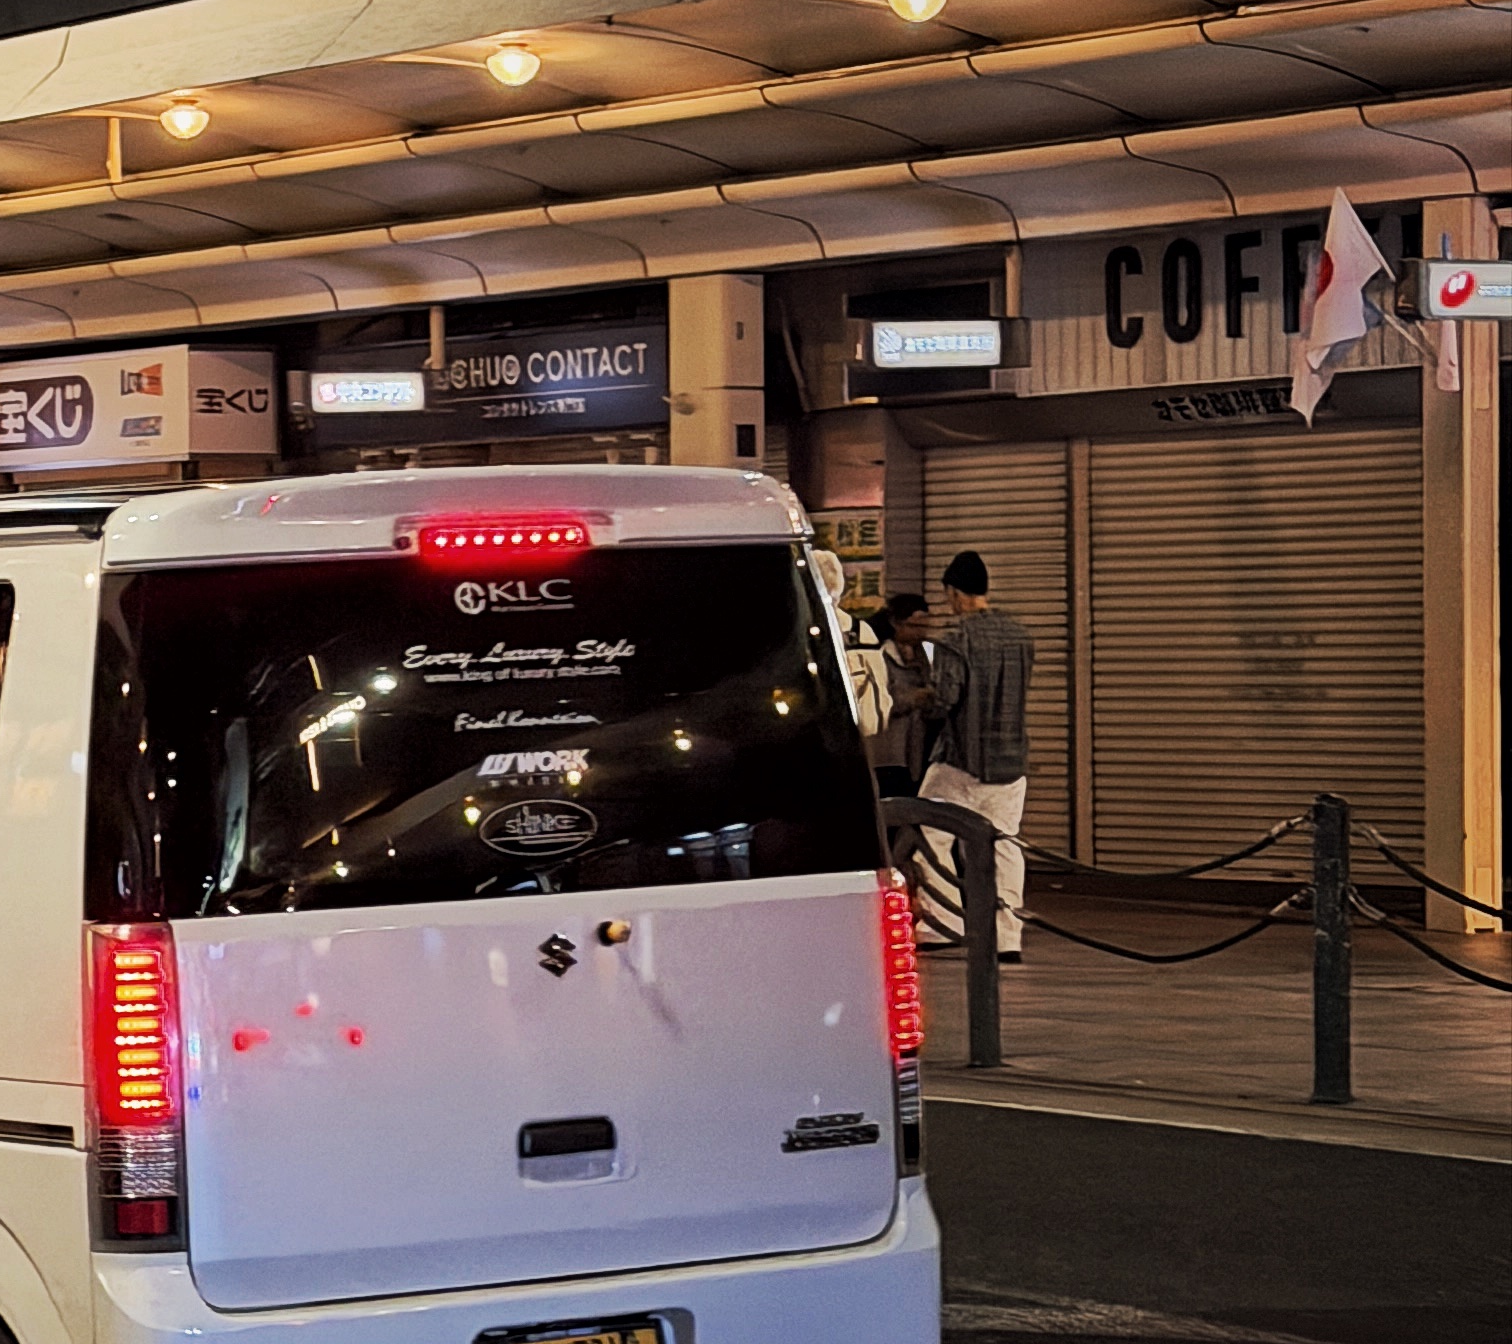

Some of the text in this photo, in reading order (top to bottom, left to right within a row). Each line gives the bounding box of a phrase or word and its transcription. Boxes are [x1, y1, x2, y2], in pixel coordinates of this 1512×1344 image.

[526, 342, 648, 383] CONTACT
[196, 387, 269, 414] 宝くじ
[488, 578, 573, 602] KLC
[518, 748, 590, 774] WORK
